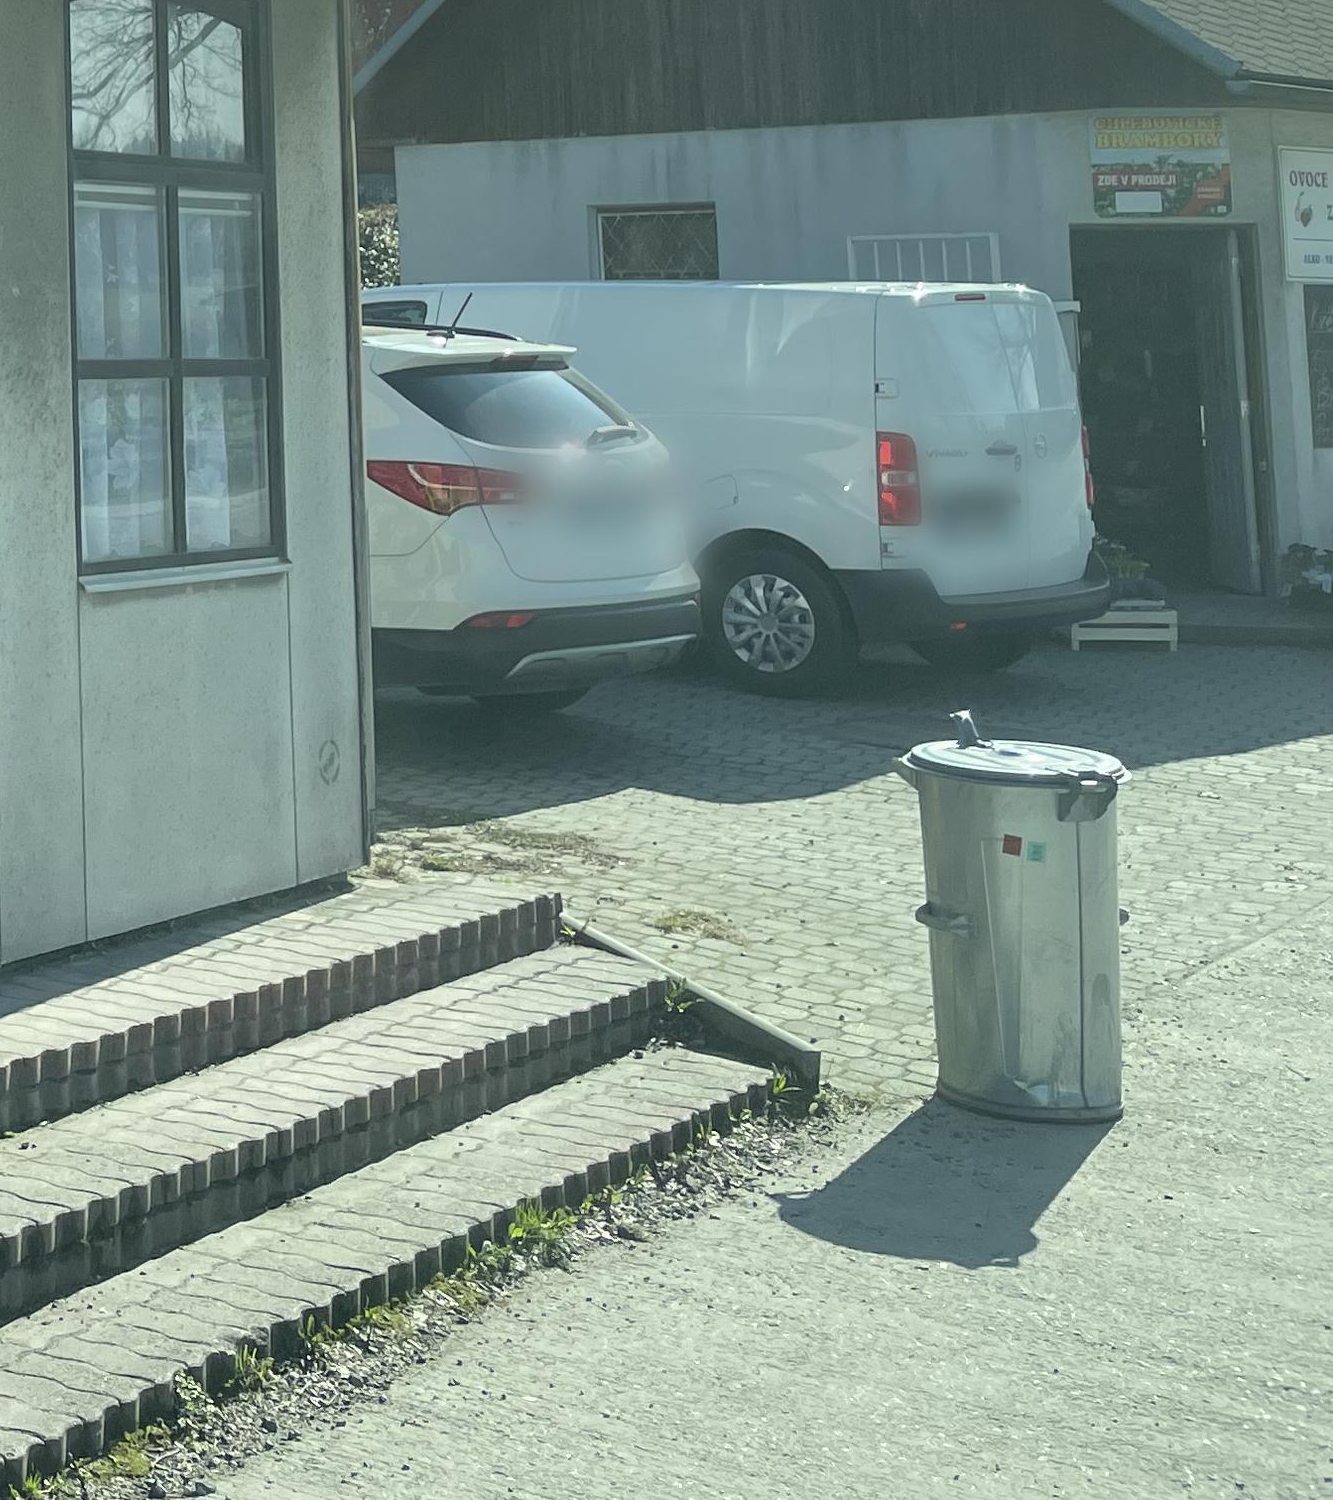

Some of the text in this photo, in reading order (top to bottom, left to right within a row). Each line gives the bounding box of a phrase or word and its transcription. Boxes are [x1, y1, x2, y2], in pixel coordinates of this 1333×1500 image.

[1095, 131, 1221, 149] BRAMBORY
[1097, 174, 1177, 186] ZDE V PRODEJI
[1289, 170, 1328, 189] OVOCE
